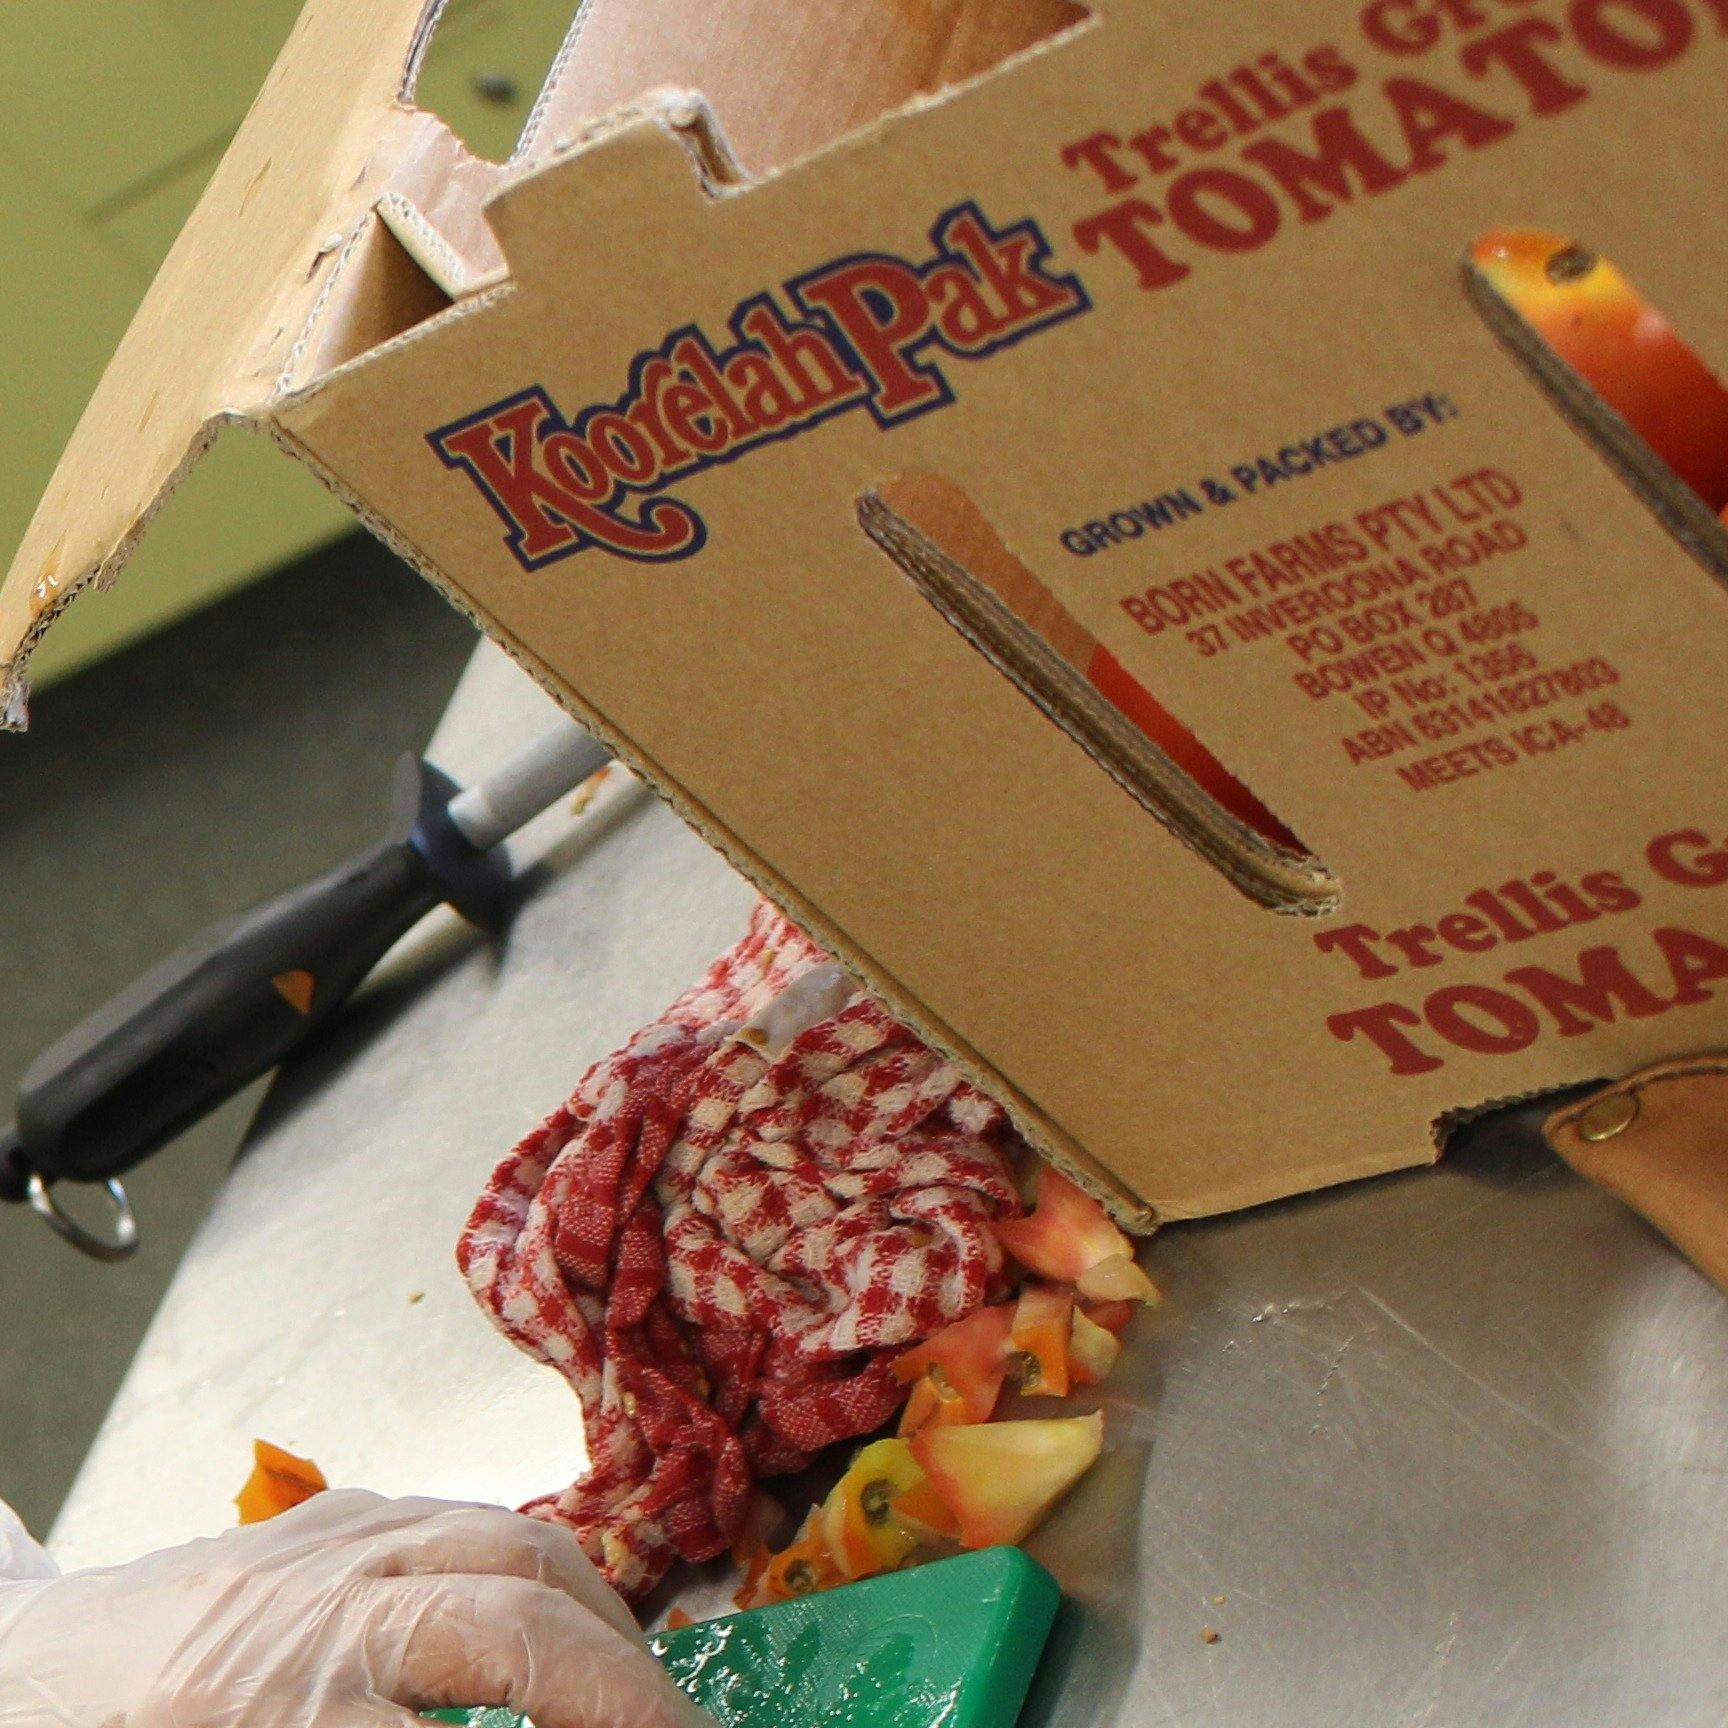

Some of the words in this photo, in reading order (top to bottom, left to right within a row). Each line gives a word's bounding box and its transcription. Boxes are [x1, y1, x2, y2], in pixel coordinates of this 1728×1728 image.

[1060, 43, 1358, 195] Trellis
[1072, 0, 1728, 290] TOMATO
[424, 293, 877, 572] Koorelah
[782, 202, 1093, 430] Pak
[1058, 488, 1204, 558] GROWN
[1199, 477, 1238, 508] &
[1231, 417, 1389, 495] PACKED
[1118, 568, 1244, 636] BORN
[1225, 521, 1369, 598] FARMS
[1354, 490, 1444, 552] PTY
[1432, 466, 1524, 524] LTD
[1184, 624, 1231, 659] 37
[1419, 517, 1529, 576] ROAD
[1286, 625, 1344, 664] PO
[1339, 601, 1425, 646] BOX
[1292, 638, 1427, 701] BOWEN
[1420, 627, 1462, 658] Q
[1342, 720, 1420, 767] ABN
[1395, 736, 1520, 791] MEETS
[1313, 870, 1642, 981] Trellis
